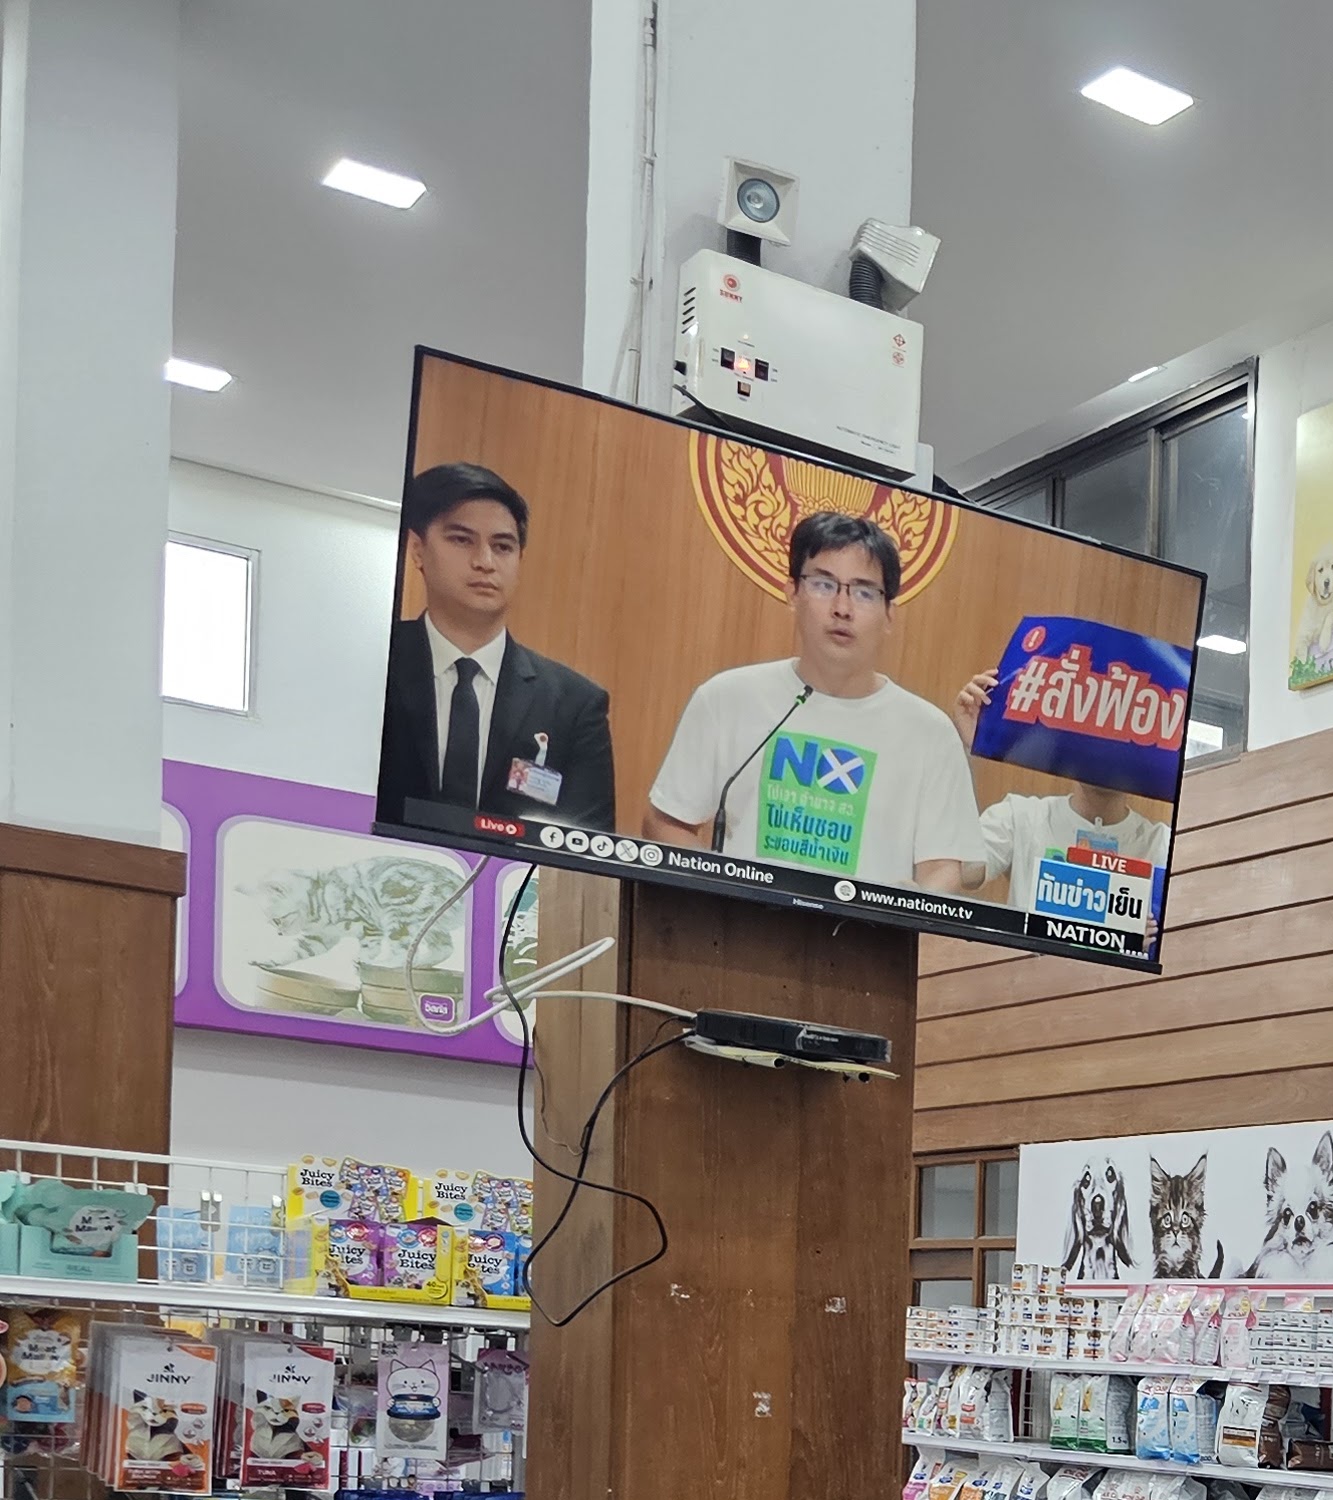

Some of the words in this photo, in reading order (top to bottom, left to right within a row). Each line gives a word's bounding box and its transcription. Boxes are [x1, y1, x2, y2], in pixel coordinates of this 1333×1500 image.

[1010, 649, 1185, 741] #สั่งฟ้อง
[480, 818, 505, 832] Live
[766, 801, 853, 844] ไม่เห็นชอบ
[668, 850, 721, 875] Nation
[724, 864, 775, 885] Online
[1091, 853, 1128, 873] LIVE
[860, 887, 974, 921] www.nationtv.tv
[1046, 920, 1127, 950] NATION
[300, 1169, 336, 1182] Juicy
[301, 1177, 334, 1189] Bites
[434, 1182, 469, 1194] Juicy
[436, 1190, 467, 1202] Bites
[398, 1249, 438, 1263] Juicy
[468, 1253, 503, 1268] Juicy
[399, 1257, 436, 1271] Bites
[468, 1261, 501, 1276] Btes
[146, 1374, 191, 1385] JINNY
[269, 1373, 312, 1385] JINNY
